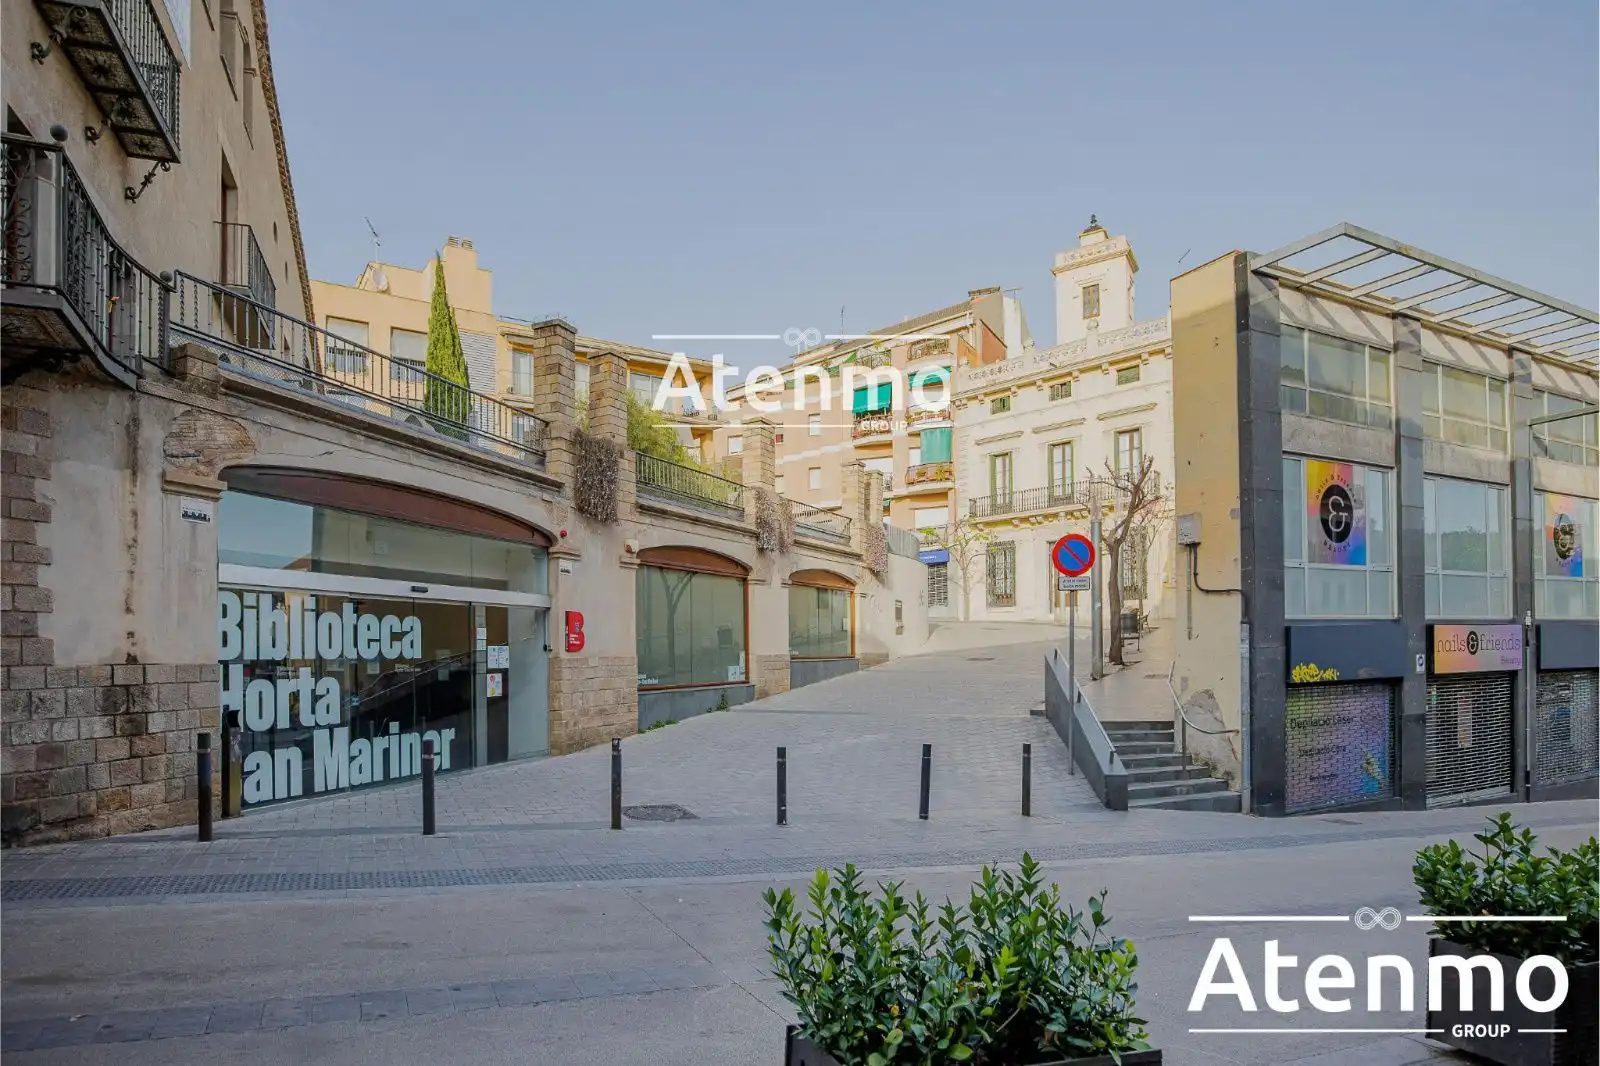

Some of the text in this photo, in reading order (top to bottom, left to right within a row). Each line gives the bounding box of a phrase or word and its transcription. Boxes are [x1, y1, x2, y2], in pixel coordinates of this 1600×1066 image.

[217, 590, 422, 661] Biblioteca
[220, 663, 341, 733] Horta
[243, 745, 303, 804] an
